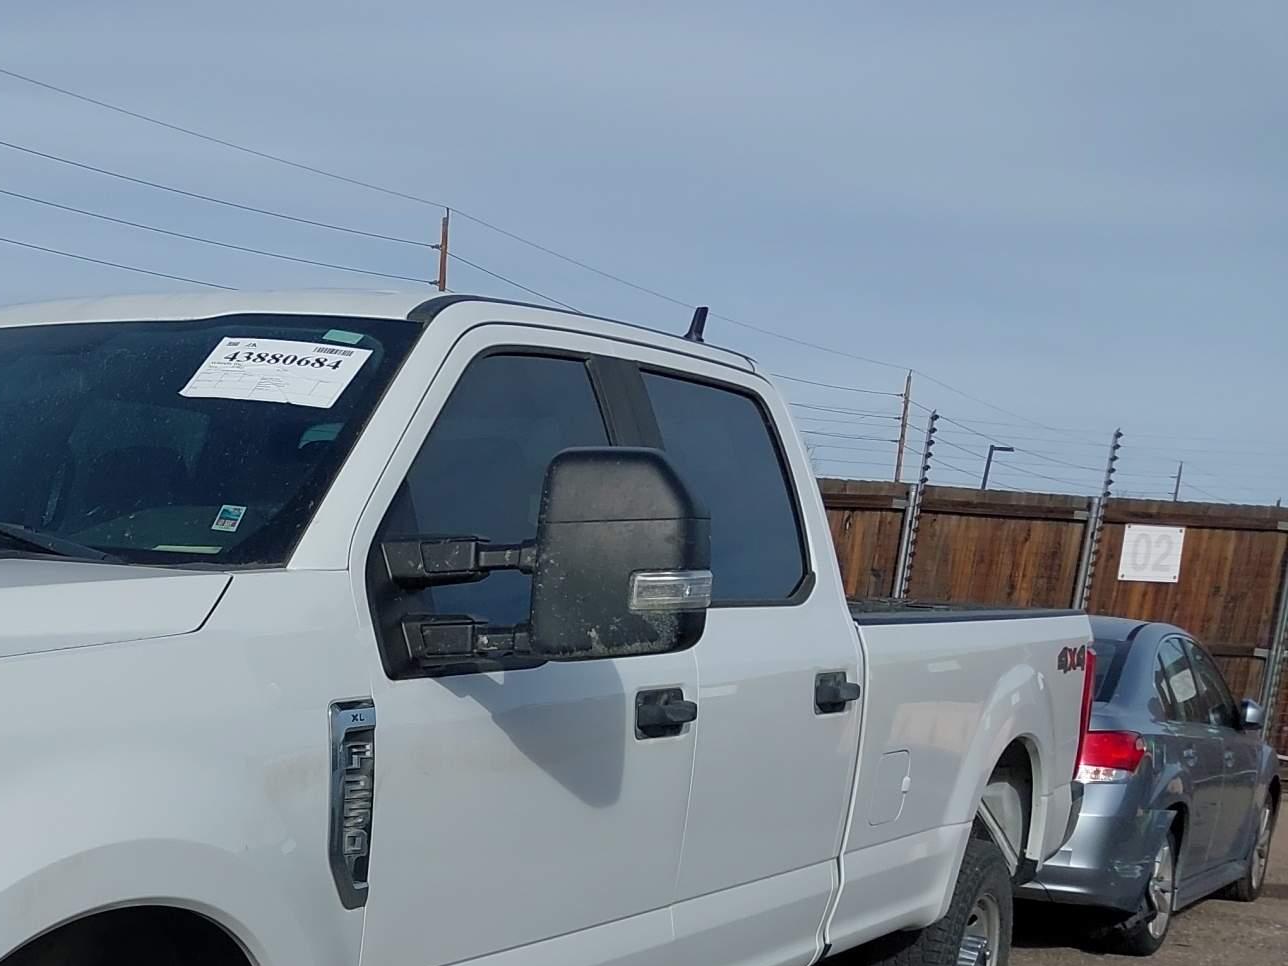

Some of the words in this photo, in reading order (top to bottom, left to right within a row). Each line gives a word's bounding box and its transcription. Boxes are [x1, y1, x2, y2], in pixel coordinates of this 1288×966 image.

[223, 351, 343, 370] 43880684
[1130, 532, 1174, 573] 02
[351, 713, 365, 723] XL
